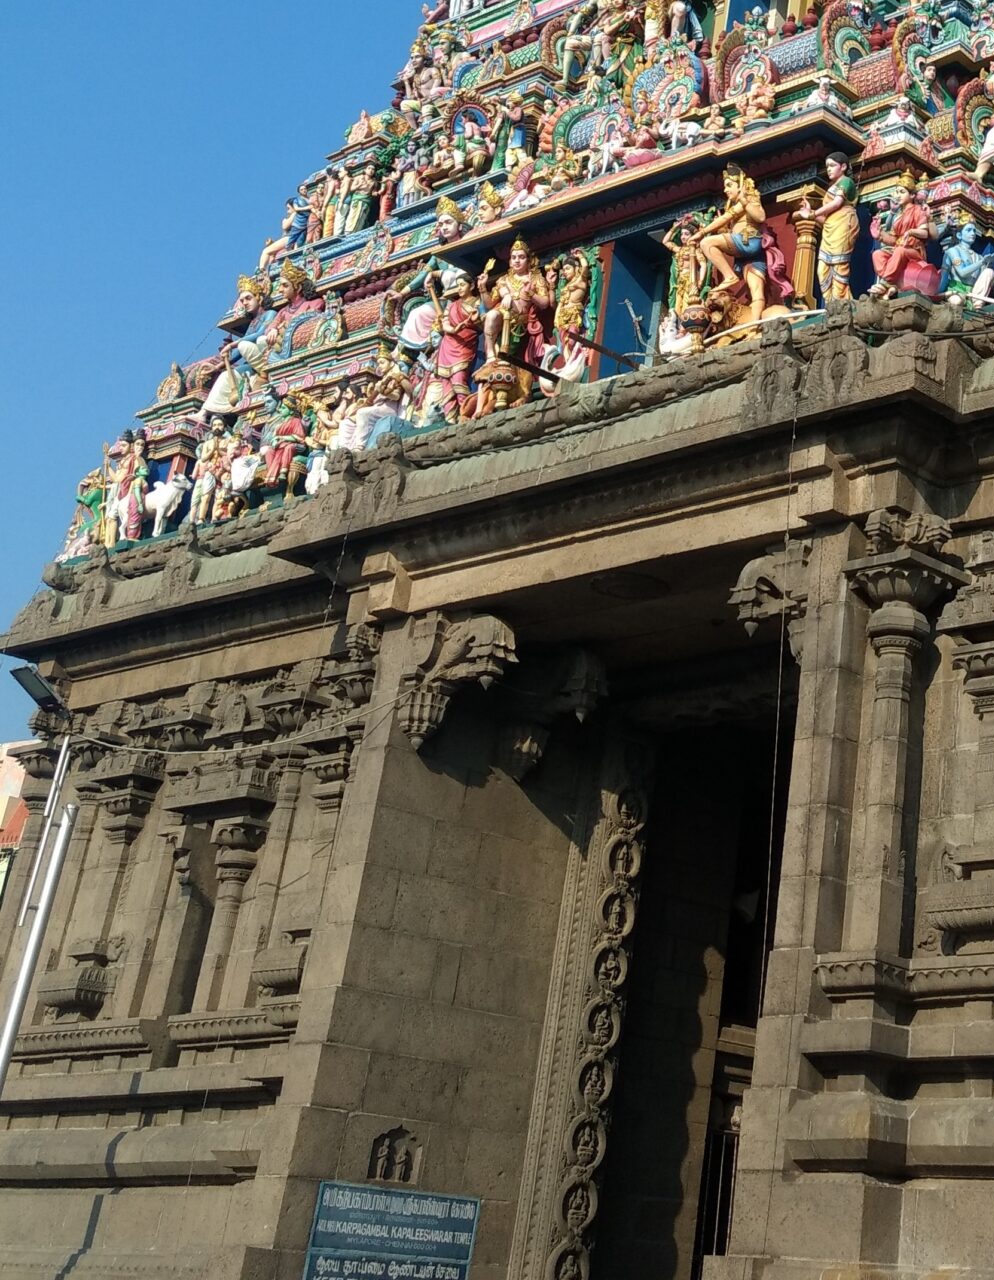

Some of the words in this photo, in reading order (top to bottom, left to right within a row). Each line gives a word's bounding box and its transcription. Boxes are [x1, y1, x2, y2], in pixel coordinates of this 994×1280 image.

[335, 1221, 390, 1238] KARPAGAMBAL
[390, 1226, 454, 1244] KAPALEESWARAR
[453, 1231, 472, 1245] TEMPLE
